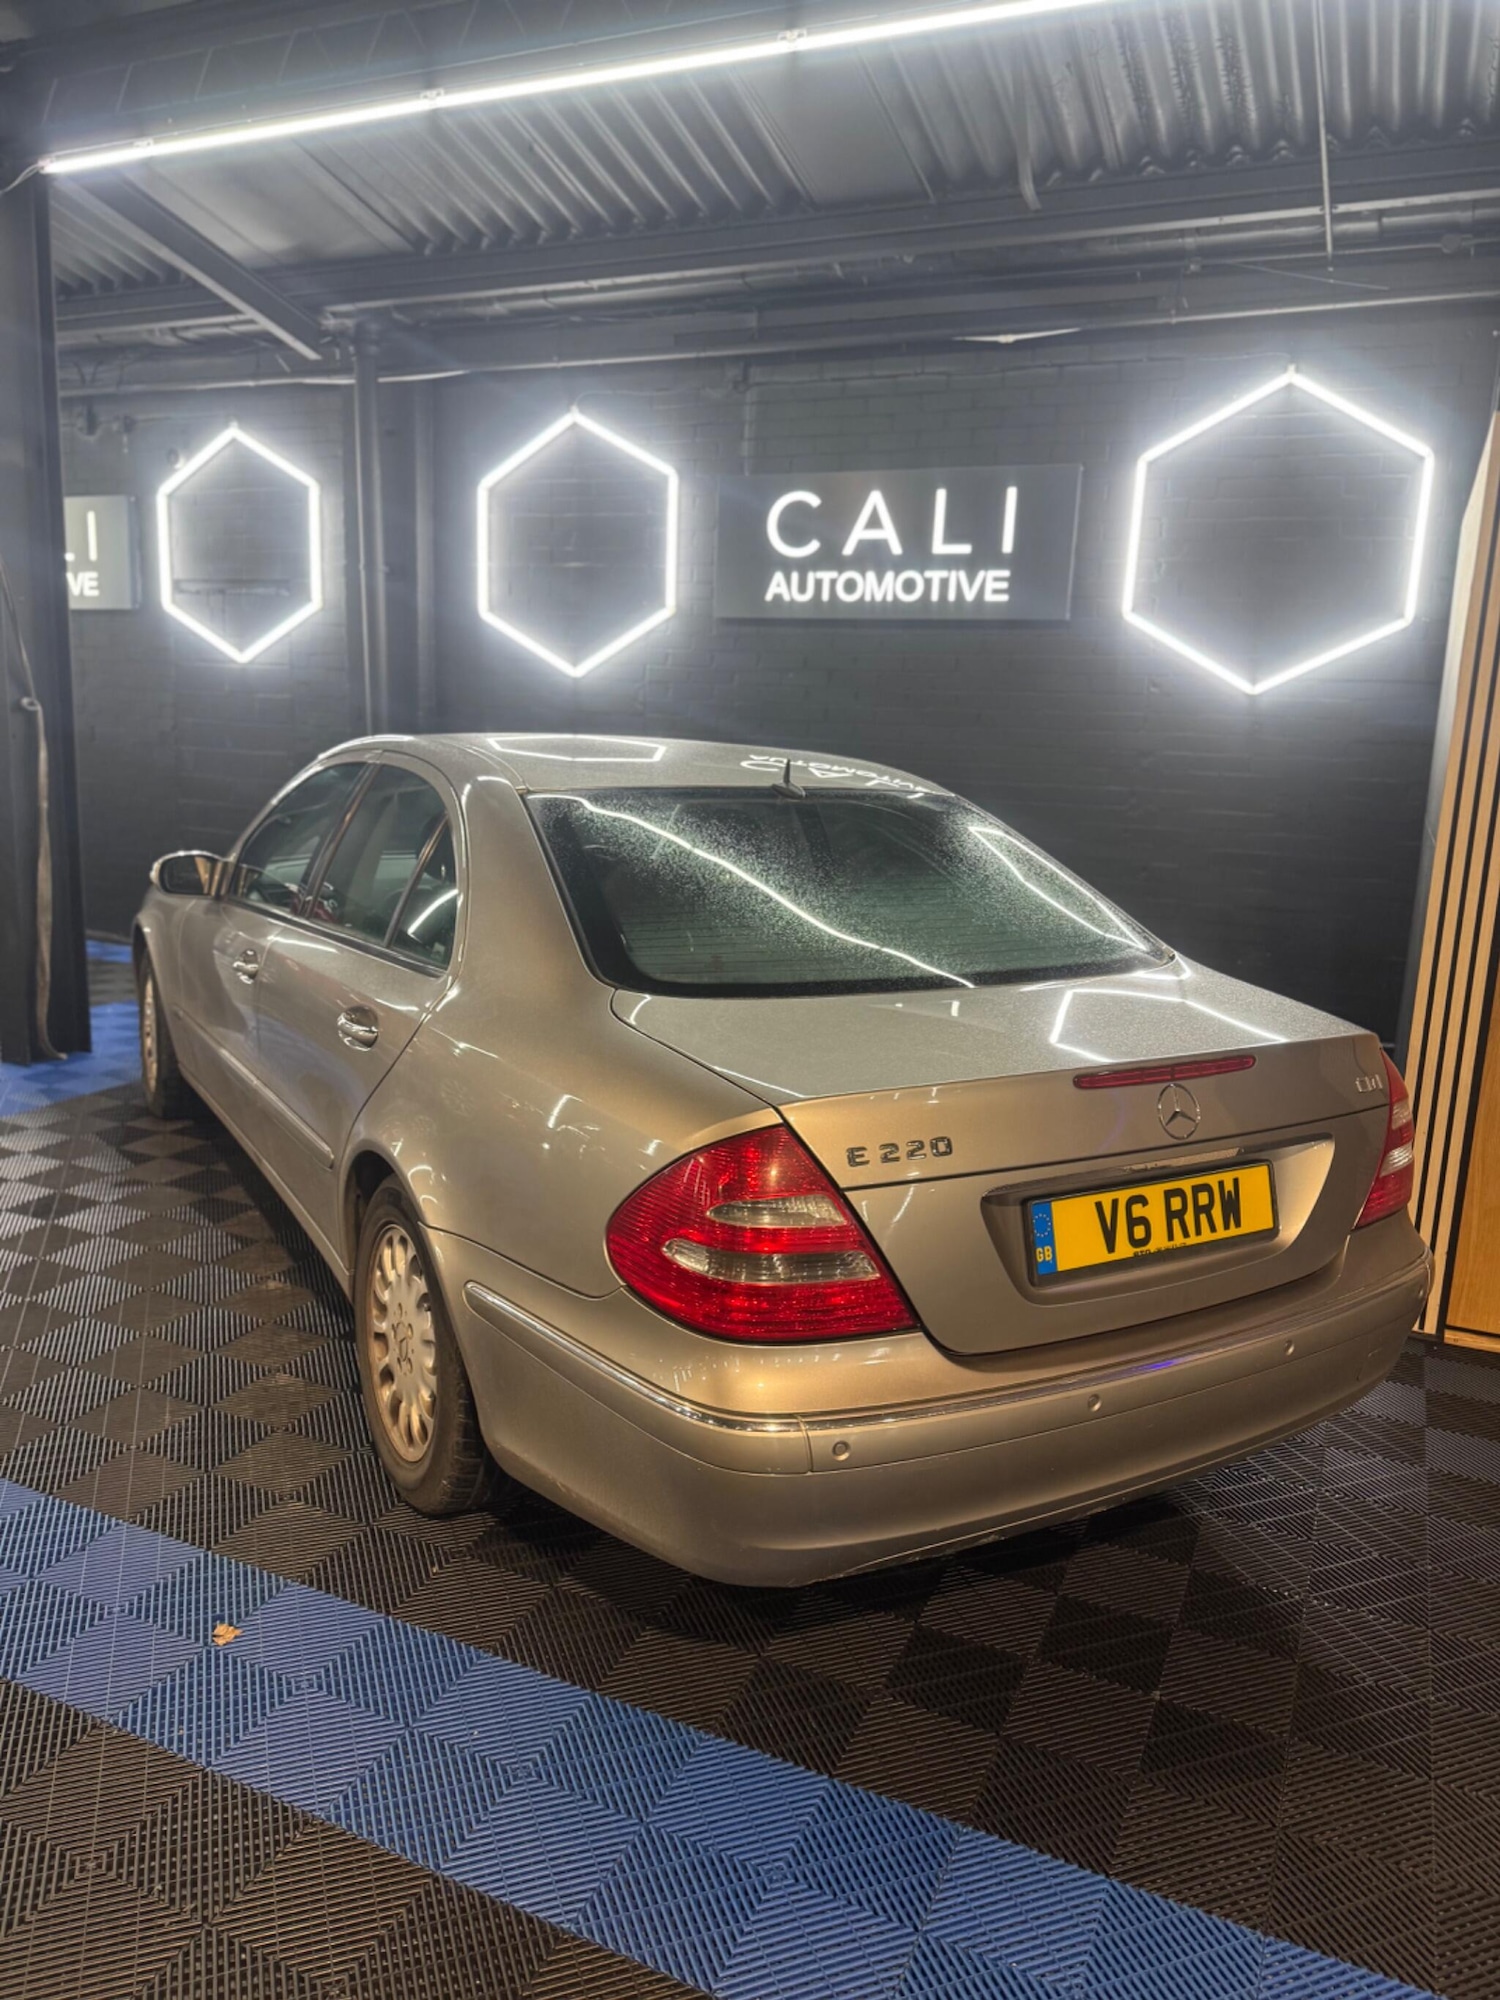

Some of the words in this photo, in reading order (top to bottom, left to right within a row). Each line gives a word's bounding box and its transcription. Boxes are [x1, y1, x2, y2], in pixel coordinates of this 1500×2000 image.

[766, 486, 1018, 558] CALI
[765, 570, 1011, 602] AUTOMOTIVE
[845, 1146, 870, 1168] E
[878, 1136, 953, 1164] 220
[1094, 1194, 1152, 1254] V6
[1163, 1177, 1242, 1242] RRW
[1036, 1246, 1053, 1262] GB
